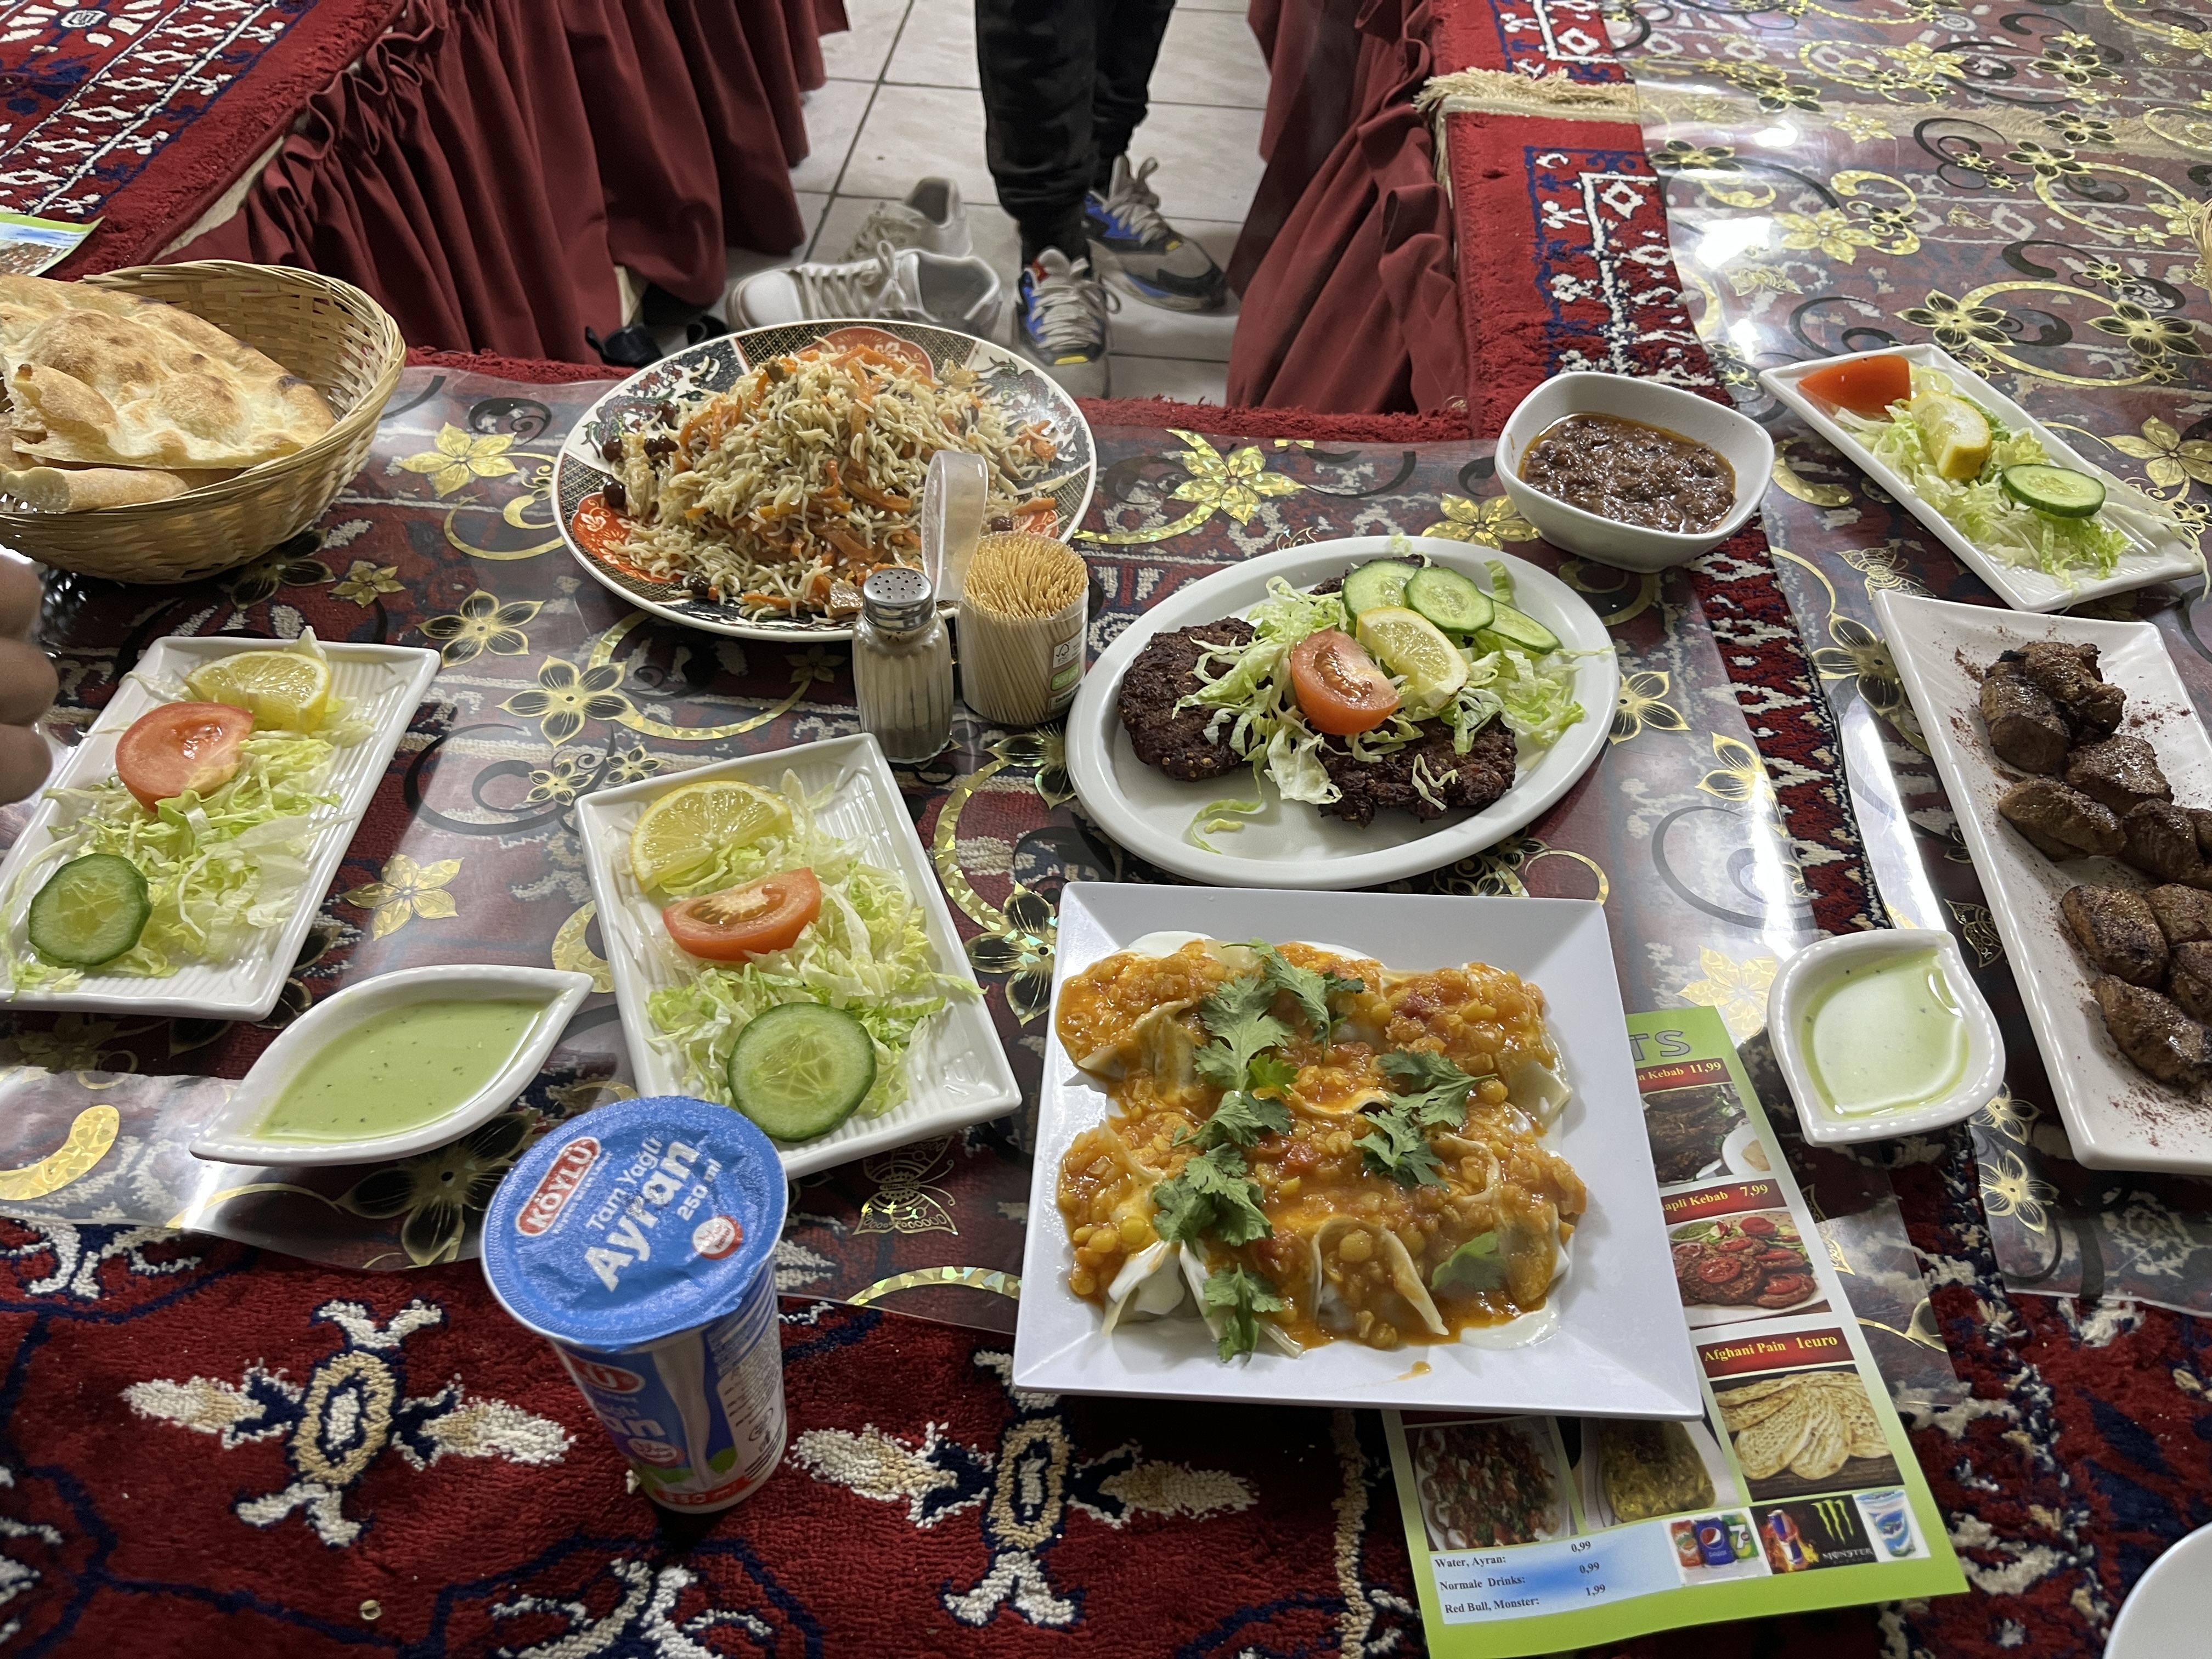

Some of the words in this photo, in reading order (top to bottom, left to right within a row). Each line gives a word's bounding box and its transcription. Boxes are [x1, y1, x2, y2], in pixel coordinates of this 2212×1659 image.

[1648, 1068, 1684, 1079] Kebab
[1689, 1062, 1722, 1074] 11,99
[526, 1143, 593, 1228] KÖYLÜ
[677, 1183, 709, 1221] 250
[703, 1158, 723, 1183] ml
[1662, 1199, 1688, 1211] apli
[1689, 1191, 1728, 1205] Kebab
[1740, 1184, 1768, 1198] 7,99
[584, 1141, 701, 1293] Ayran
[585, 1187, 628, 1230] Tam
[1705, 1344, 1755, 1362] Afghani
[1756, 1341, 1786, 1354] Pain
[1795, 1336, 1838, 1349] 1euro
[1435, 1558, 1470, 1567] Water,
[1472, 1556, 1506, 1567] Ayran:
[1571, 1541, 1592, 1553] 0,99
[1821, 1548, 1874, 1560] MONSTER
[1439, 1579, 1482, 1591] Normale
[1488, 1576, 1525, 1587] Drinks:
[1579, 1562, 1600, 1574] 0,99
[1444, 1603, 1465, 1613] Red
[1468, 1601, 1492, 1612] Bull,
[1494, 1597, 1539, 1610] Monster:
[1585, 1584, 1606, 1596] 1,99
